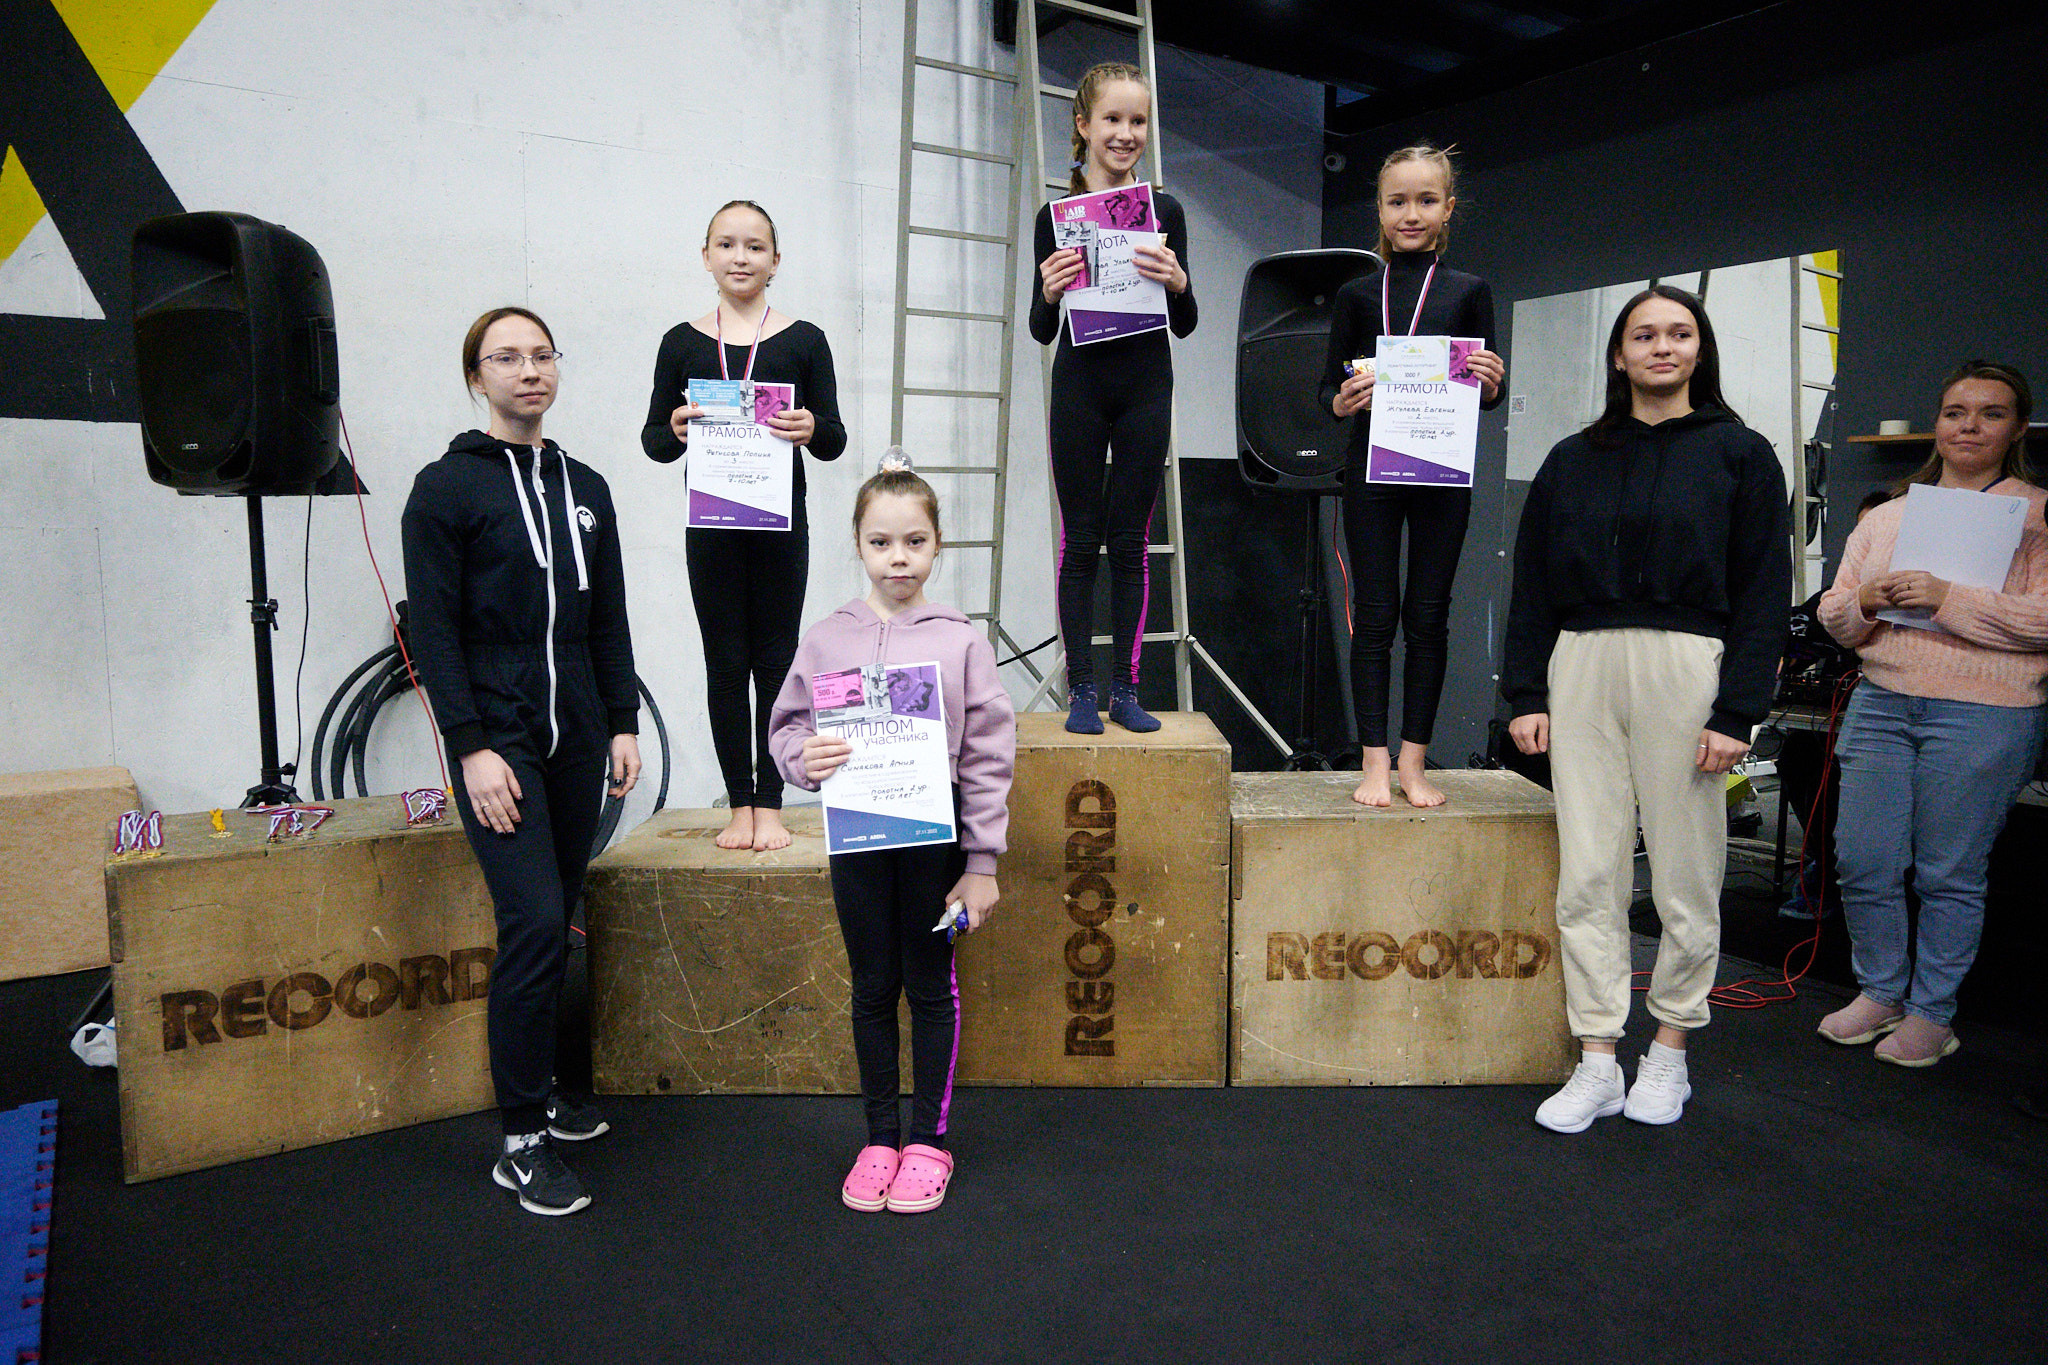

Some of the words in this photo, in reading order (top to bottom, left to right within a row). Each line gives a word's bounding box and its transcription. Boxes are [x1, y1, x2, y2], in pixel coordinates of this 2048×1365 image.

[701, 425, 762, 439] ГРАМОТА
[743, 450, 771, 458] Полина
[835, 718, 914, 741] ДИПЛОМ
[863, 732, 929, 750] участника
[889, 759, 915, 769] Агния
[1064, 779, 1117, 1057] RECORD
[1266, 929, 1551, 982] RECORD
[161, 946, 496, 1052] RECORD
